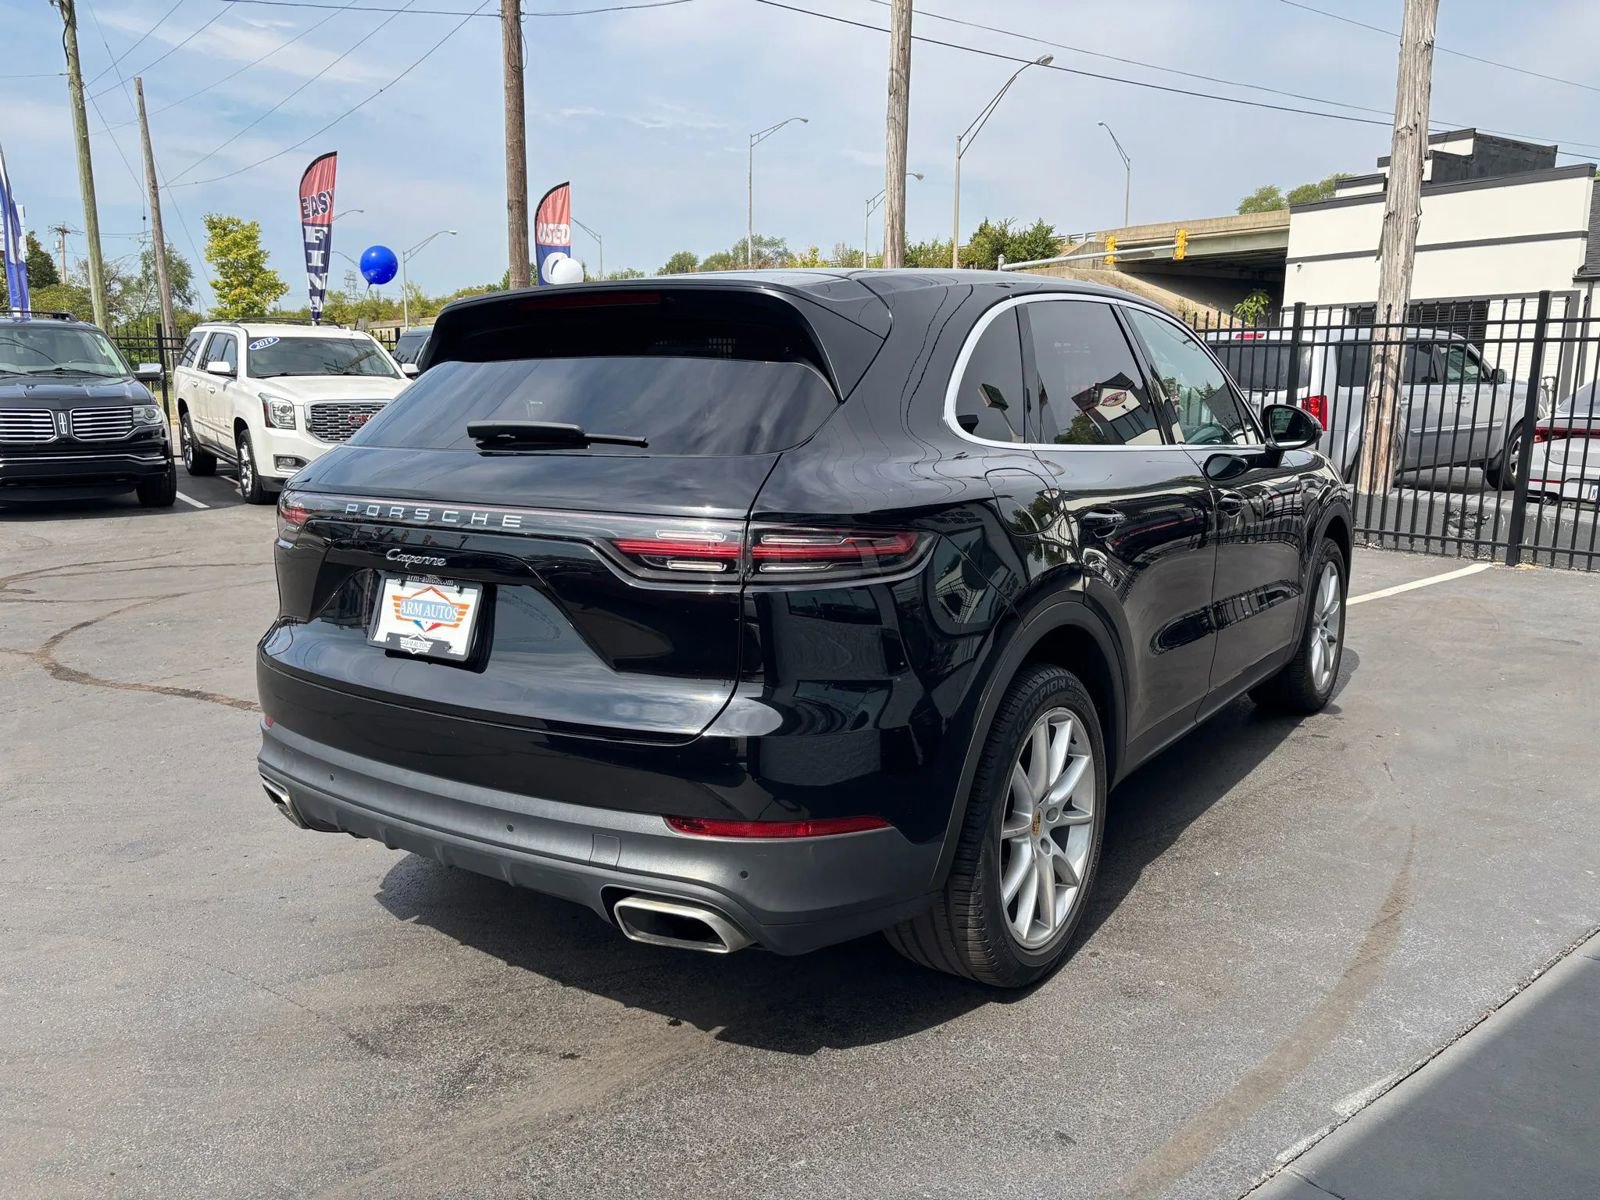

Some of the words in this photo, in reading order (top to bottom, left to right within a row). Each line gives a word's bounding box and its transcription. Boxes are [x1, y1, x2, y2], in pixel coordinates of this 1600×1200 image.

[301, 189, 334, 219] EASY
[538, 223, 570, 245] USED
[345, 502, 523, 528] PORSCHE
[385, 548, 447, 569] Cayenne
[400, 600, 423, 616] ARM
[423, 602, 459, 621] AUTOS
